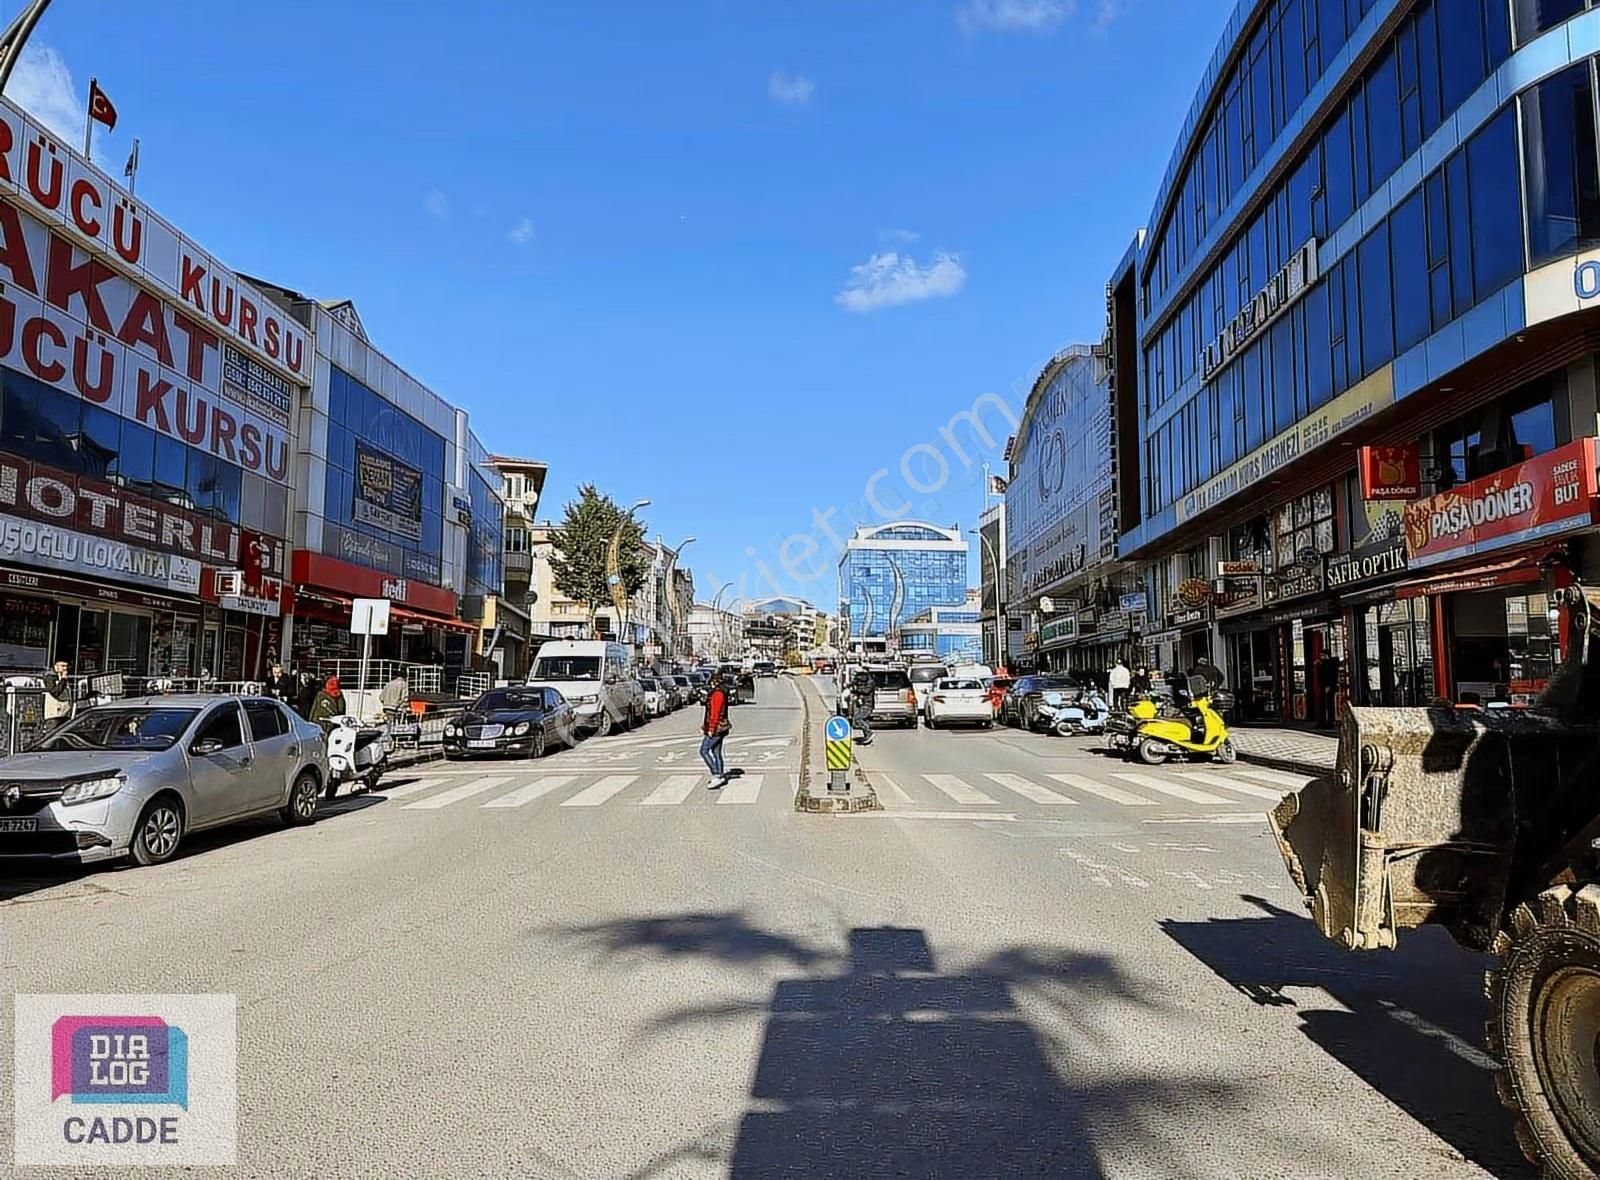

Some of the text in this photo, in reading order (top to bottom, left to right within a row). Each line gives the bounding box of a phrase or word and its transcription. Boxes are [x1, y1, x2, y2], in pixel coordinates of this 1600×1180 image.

[181, 255, 303, 373] KURSU
[135, 367, 288, 482] KURSU
[1239, 456, 1261, 488] KURS
[1261, 425, 1300, 476] MERKEZİ
[1432, 482, 1533, 540] PAŞA DÖNER
[1554, 482, 1580, 505] BUT
[83, 538, 170, 580] LOKANTA
[1223, 561, 1256, 573] Kodak
[1327, 559, 1362, 587] SAFİR
[1362, 545, 1406, 577] OPTİK
